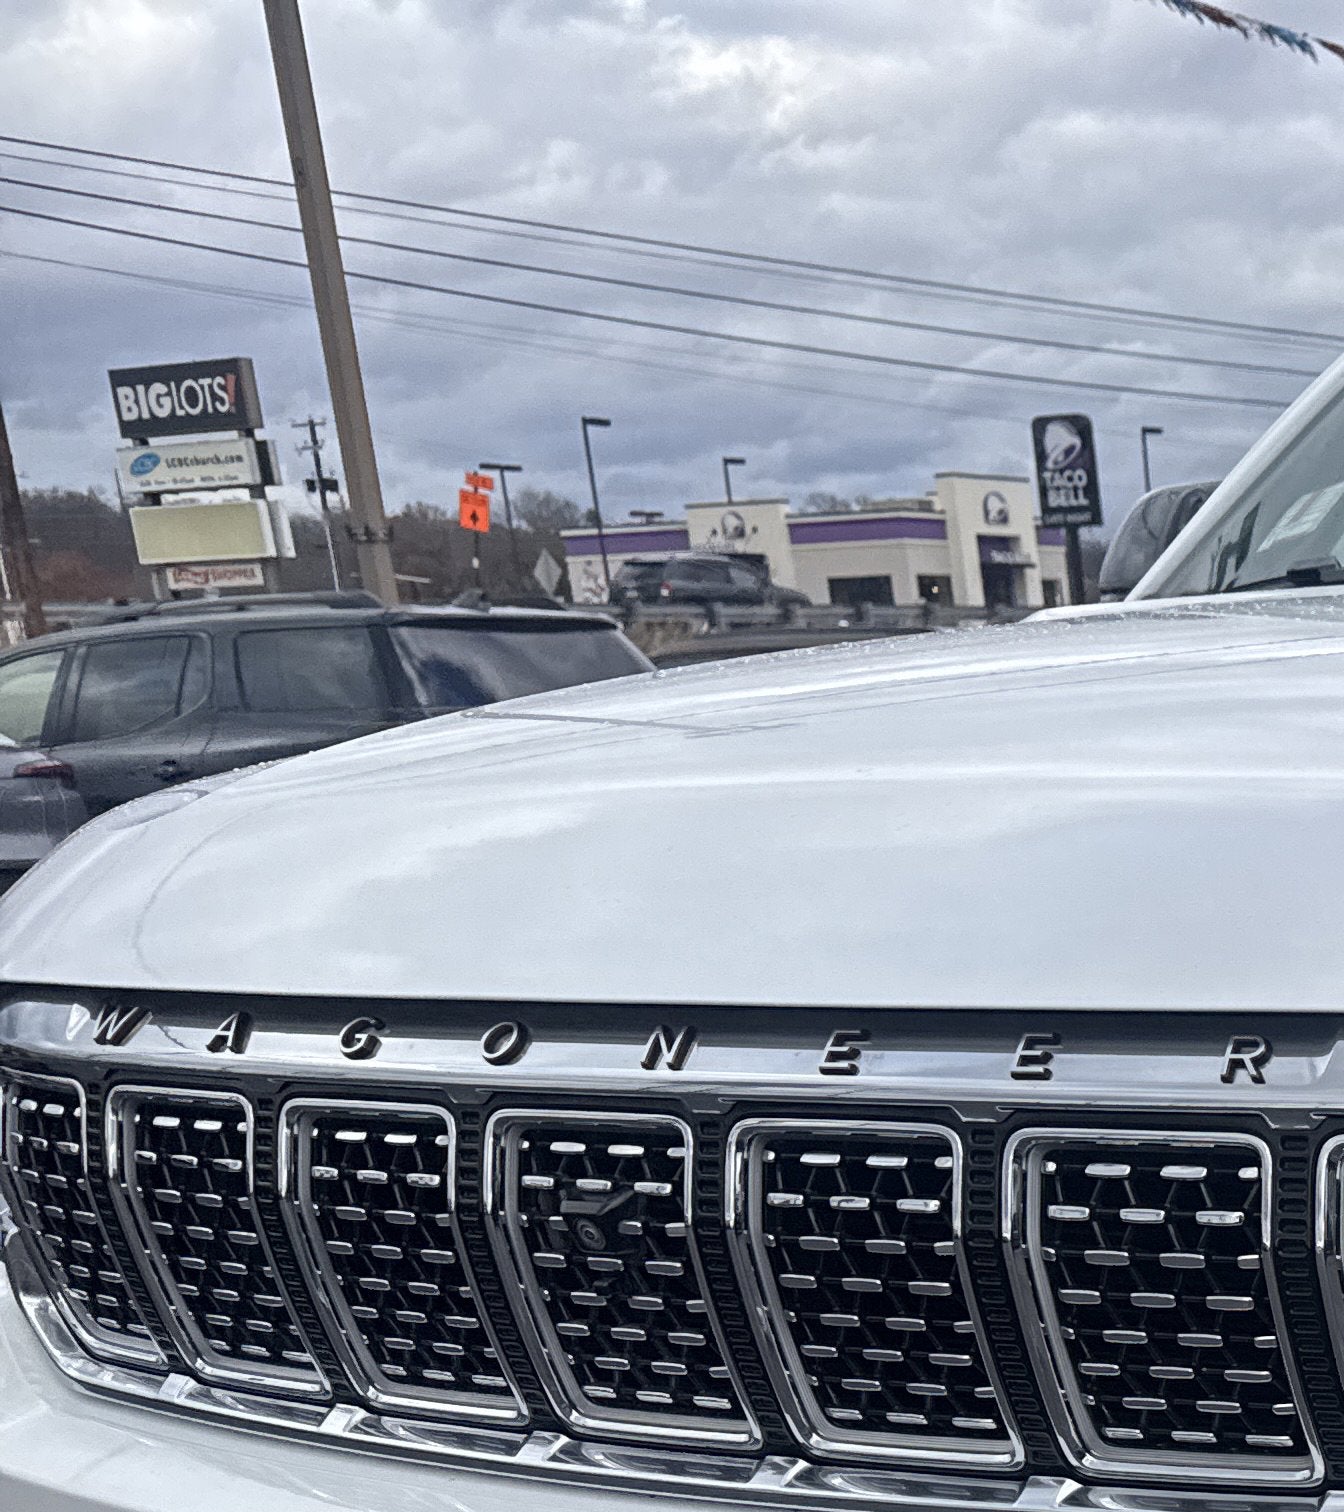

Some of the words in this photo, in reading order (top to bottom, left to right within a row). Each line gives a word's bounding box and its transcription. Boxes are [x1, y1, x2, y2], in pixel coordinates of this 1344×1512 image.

[1042, 468, 1088, 488] TACO
[1047, 487, 1090, 507] BELL
[93, 1004, 1274, 1085] WAGONEER
